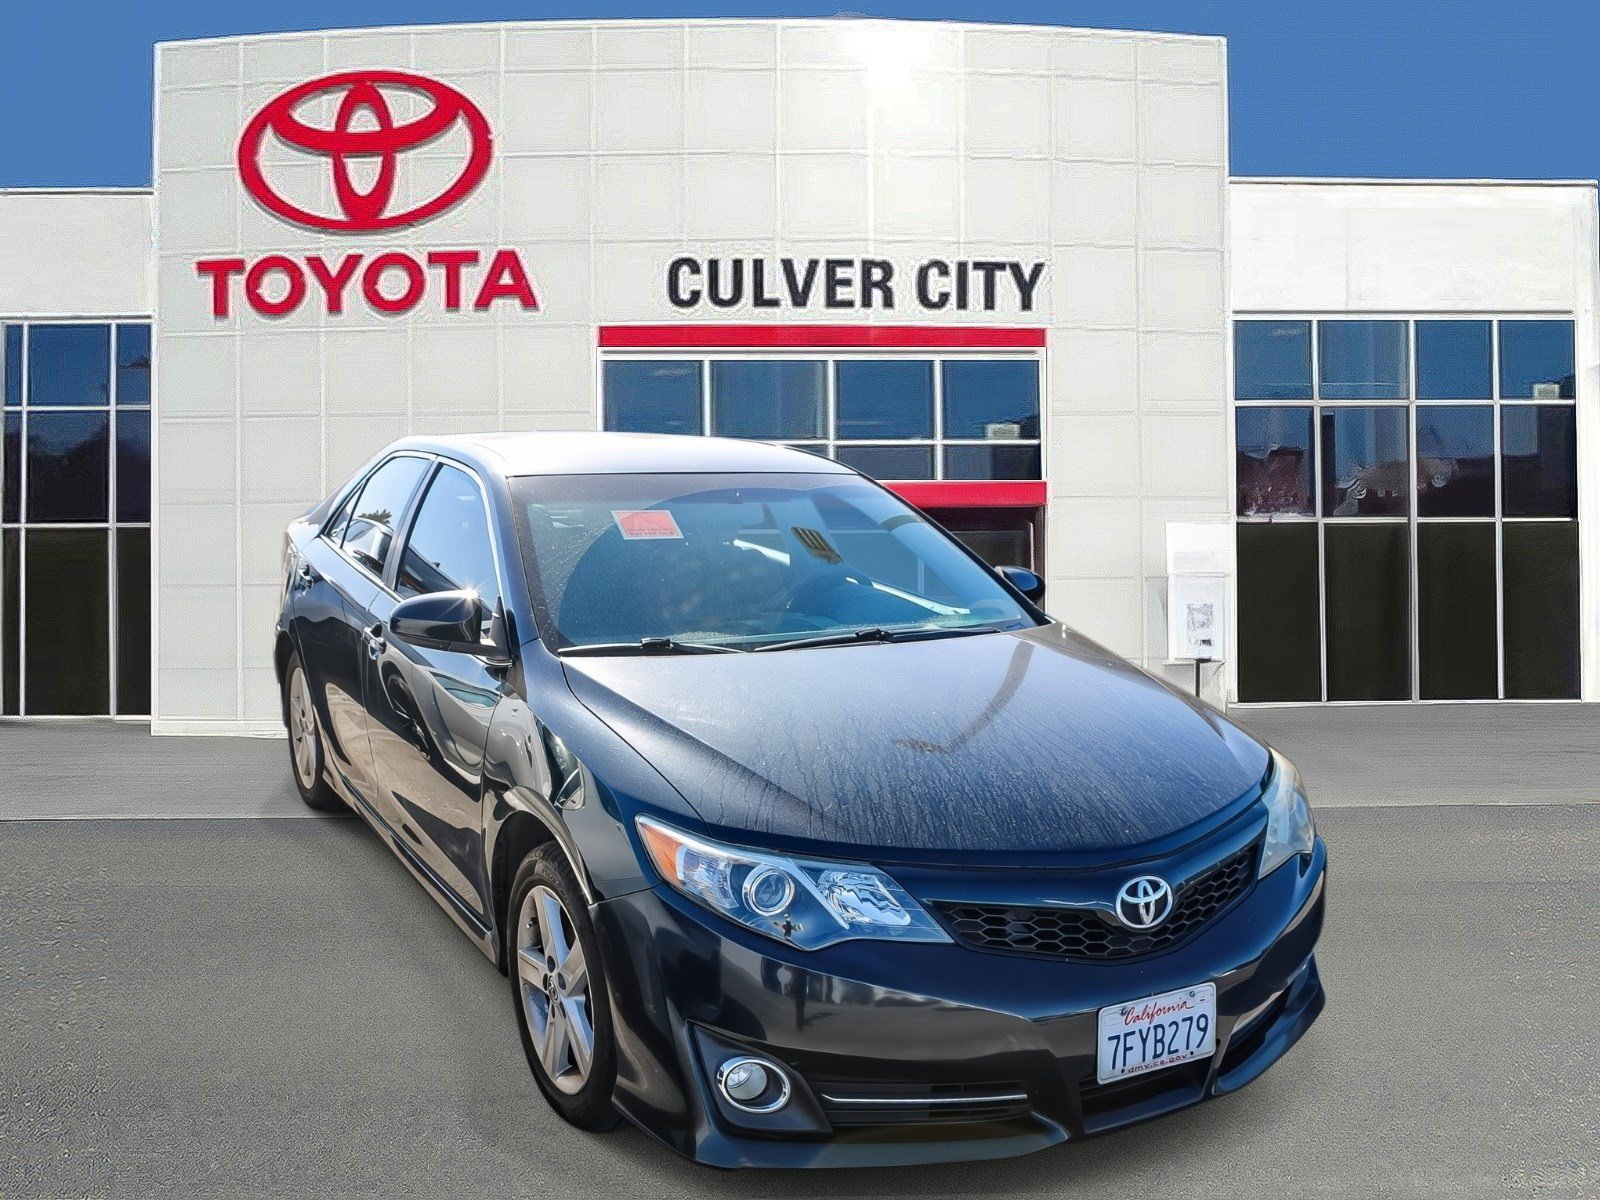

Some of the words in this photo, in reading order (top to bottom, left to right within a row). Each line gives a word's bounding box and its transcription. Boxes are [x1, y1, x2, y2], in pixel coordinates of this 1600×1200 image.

[196, 249, 540, 320] TOYOTA
[667, 256, 895, 310] CULVER
[916, 258, 1046, 311] CITY
[1124, 997, 1194, 1026] California
[1107, 1013, 1209, 1070] 7FYB279
[1128, 1053, 1188, 1074] dmv.ca.gov
